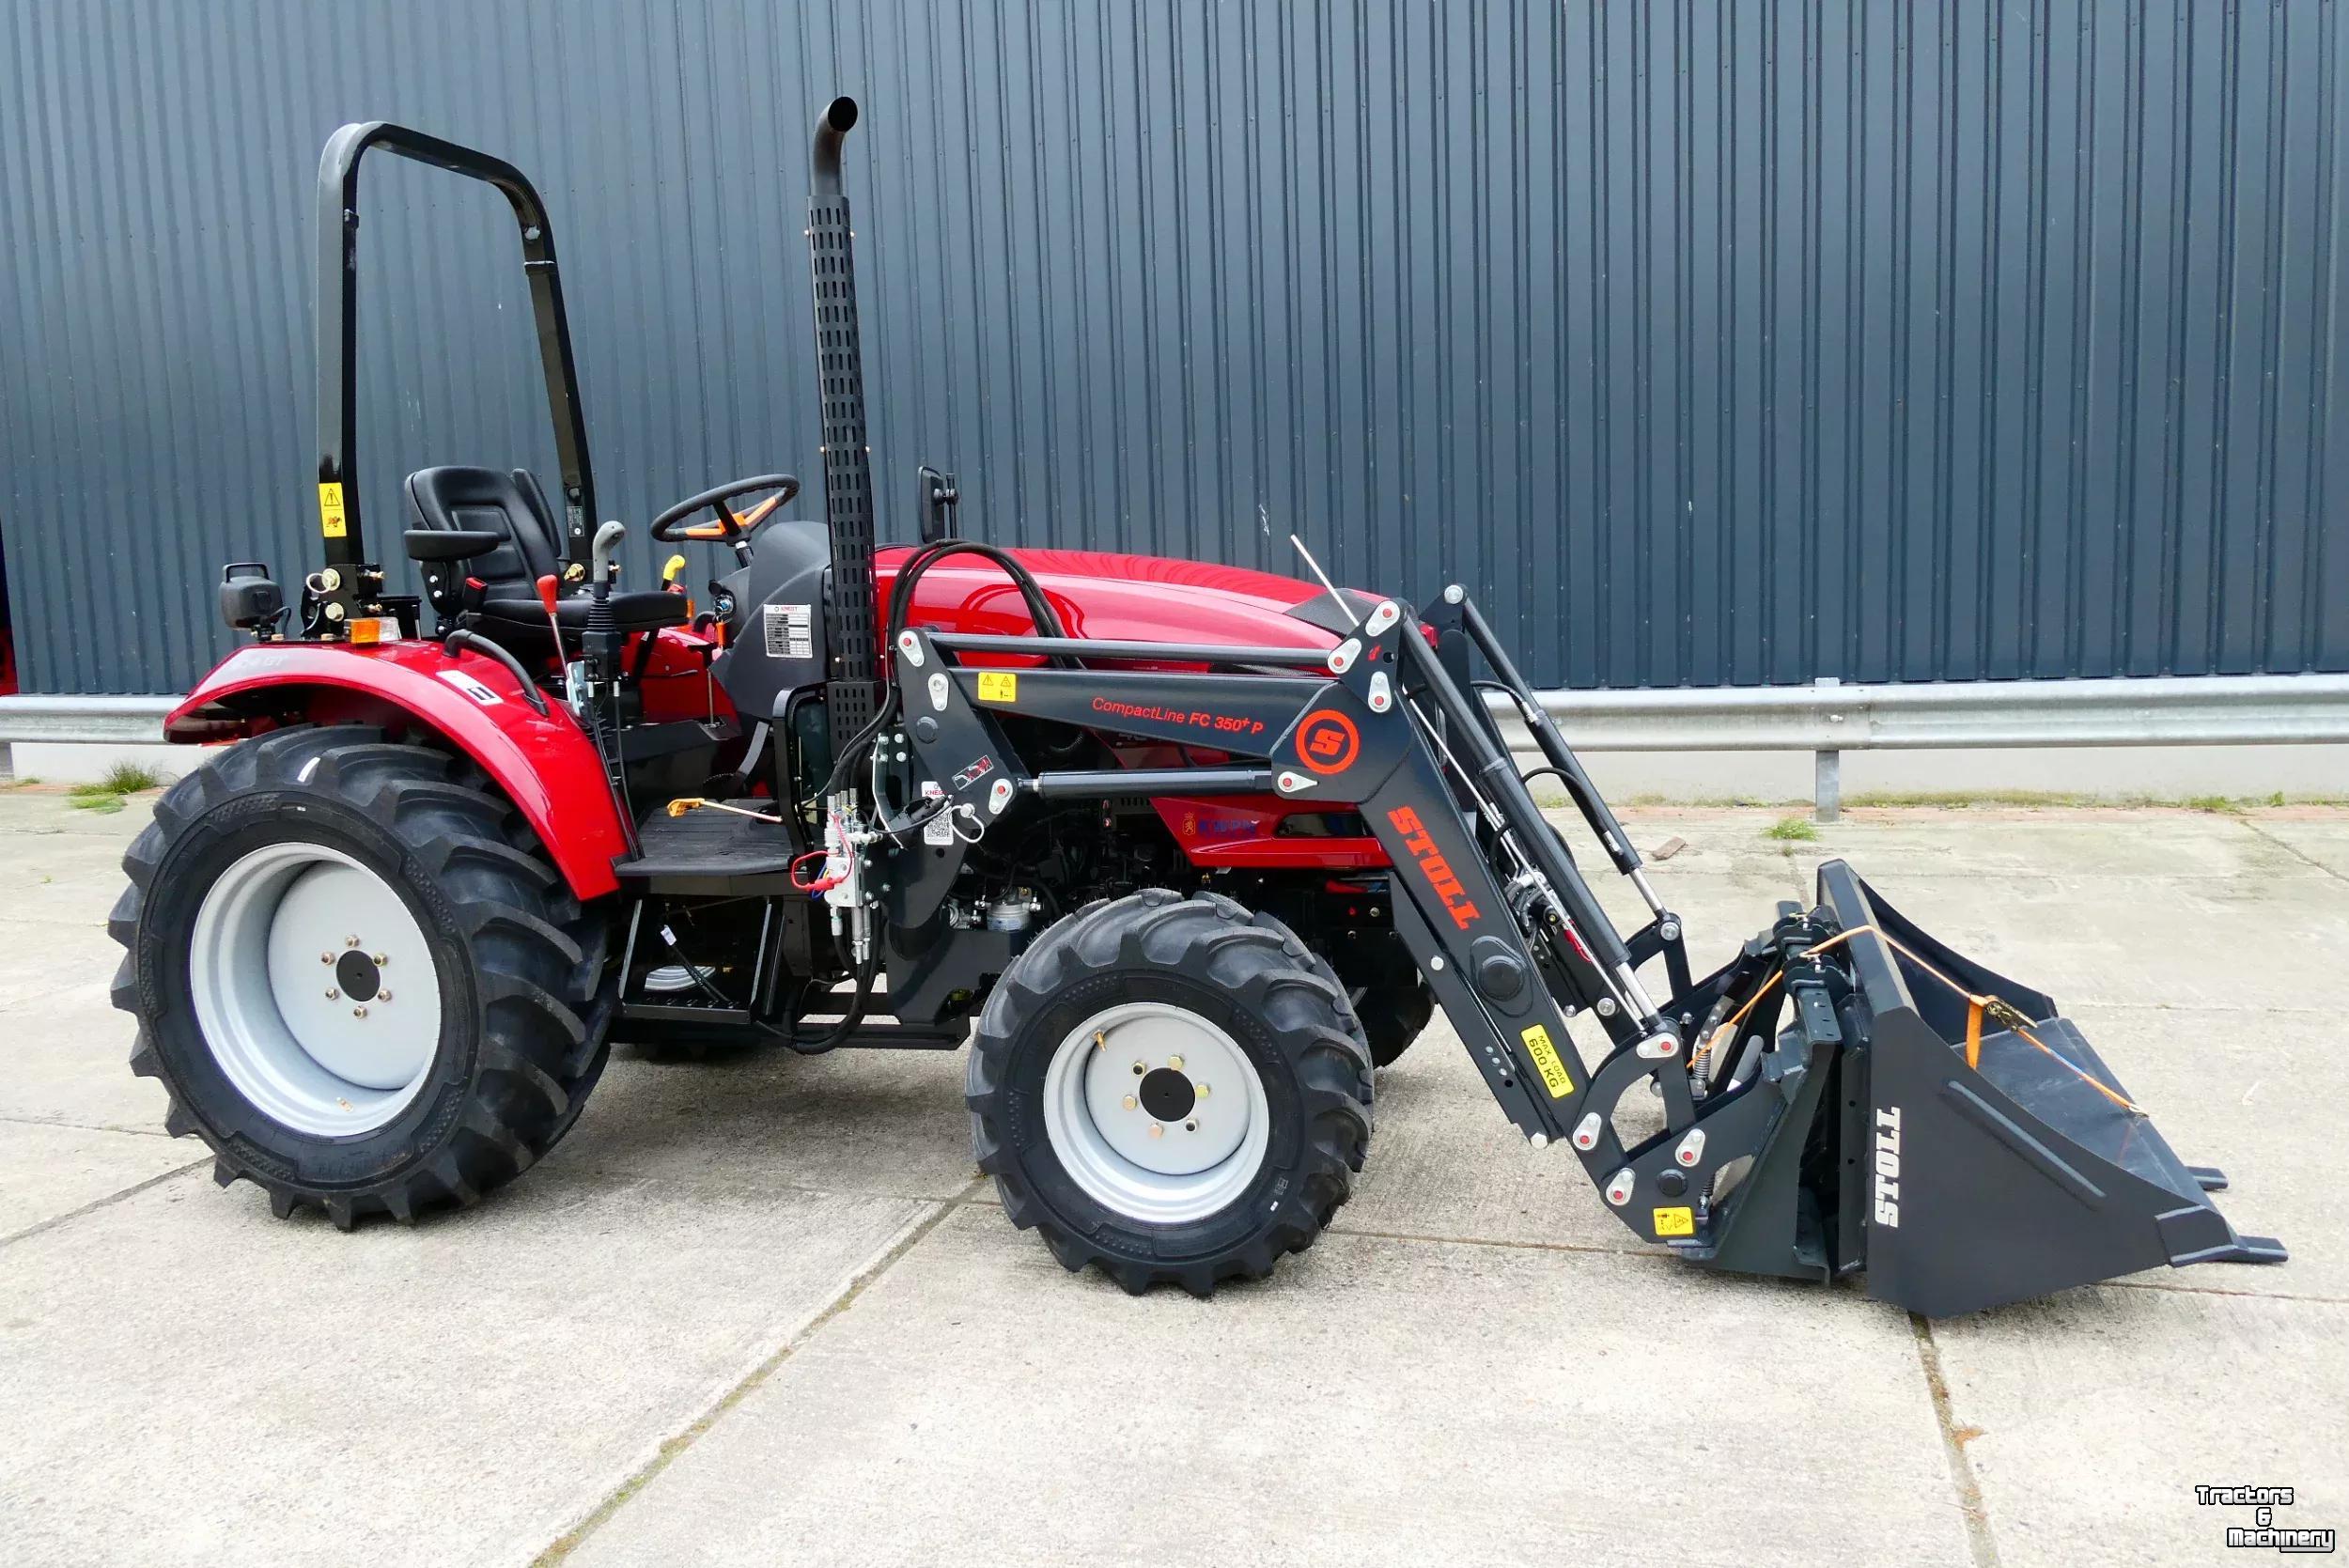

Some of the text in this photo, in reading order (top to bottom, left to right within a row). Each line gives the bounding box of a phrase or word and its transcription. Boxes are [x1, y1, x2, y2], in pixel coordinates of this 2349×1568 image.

[1092, 697, 1186, 723] CompactLine
[1189, 712, 1210, 727] FC
[1251, 721, 1264, 735] P
[1387, 806, 1481, 930] STOLL
[1529, 1038, 1559, 1088] 600 KG
[1539, 1035, 1566, 1084] MAX LOAD
[1875, 1106, 1900, 1228] STOLL
